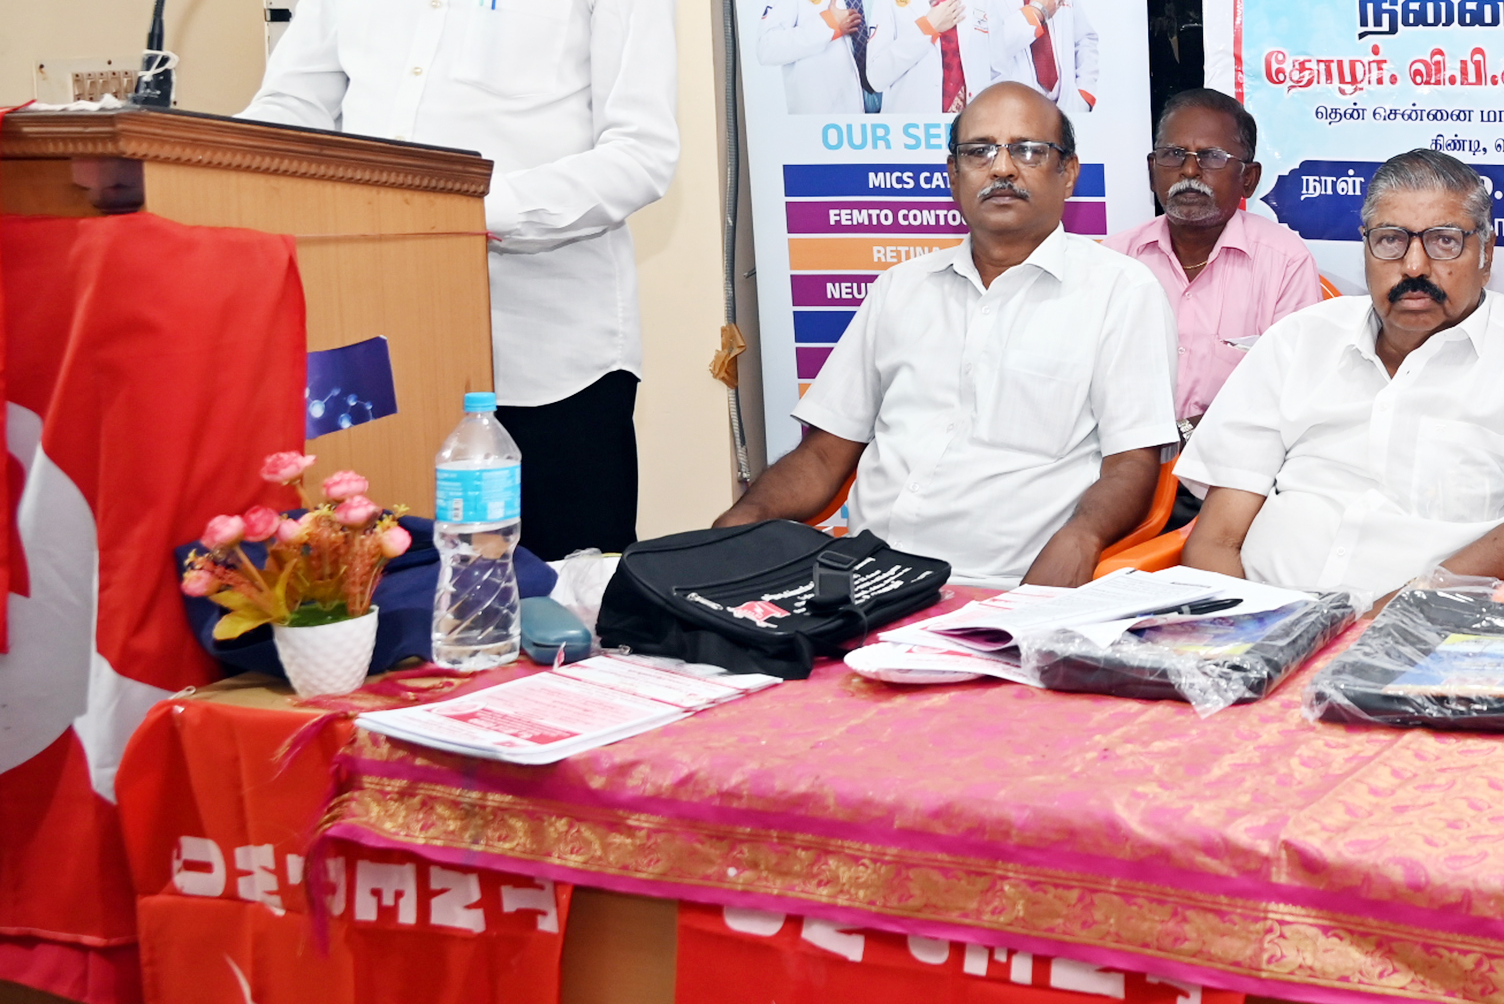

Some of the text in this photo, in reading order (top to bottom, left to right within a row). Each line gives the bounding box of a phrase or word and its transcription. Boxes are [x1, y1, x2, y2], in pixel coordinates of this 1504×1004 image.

[1264, 45, 1398, 96] தோழர்.
[1314, 102, 1367, 125] தென்
[1372, 102, 1474, 123] சென்னை
[821, 122, 952, 151] OUR SE
[868, 172, 951, 190] MICS CAT
[1300, 168, 1365, 201] நாள்
[828, 208, 968, 227] FEMTO CONTO
[826, 282, 872, 300] NEU
